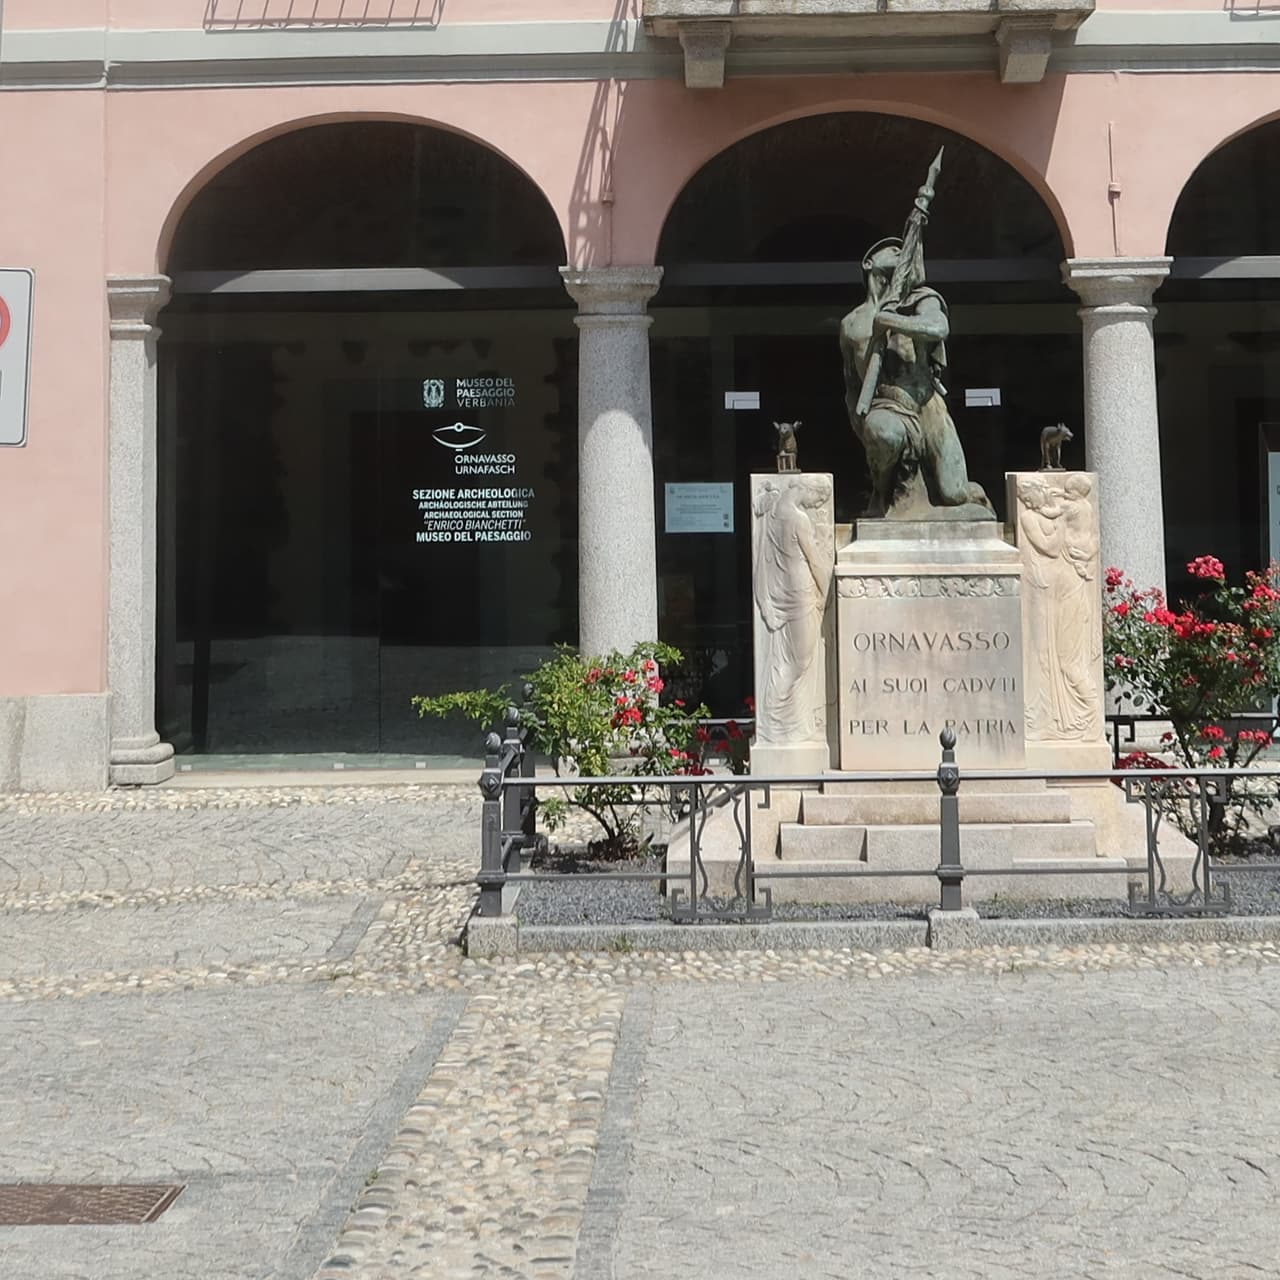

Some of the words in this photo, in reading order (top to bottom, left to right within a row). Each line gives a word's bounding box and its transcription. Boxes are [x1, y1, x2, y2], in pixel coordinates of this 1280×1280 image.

[456, 378, 494, 388] MUSEO
[495, 378, 515, 387] DEL
[456, 388, 516, 398] PAESAGGIO
[457, 398, 516, 408] VERBANIA
[454, 454, 516, 464] ORNAVASSO
[455, 465, 516, 475] URNAFASCH
[412, 489, 456, 499] SEZIONE
[457, 487, 535, 499] ARCHEOLOGICA
[418, 500, 486, 510] ARCHÄOLOGISCHE
[487, 500, 529, 509] ABTEILUNG
[423, 511, 490, 519] ARCHAEOLOGICAL
[491, 510, 524, 518] SECTION
[416, 532, 452, 542] MUSEO
[454, 532, 473, 541] DEL
[475, 531, 532, 541] PAESAGGIO
[853, 631, 1011, 652] ORNAVASSO
[849, 678, 867, 694] AI
[882, 678, 928, 694] SUOI
[848, 720, 889, 736] PER
[903, 720, 931, 736] LA
[944, 719, 1017, 736] PATRIA
